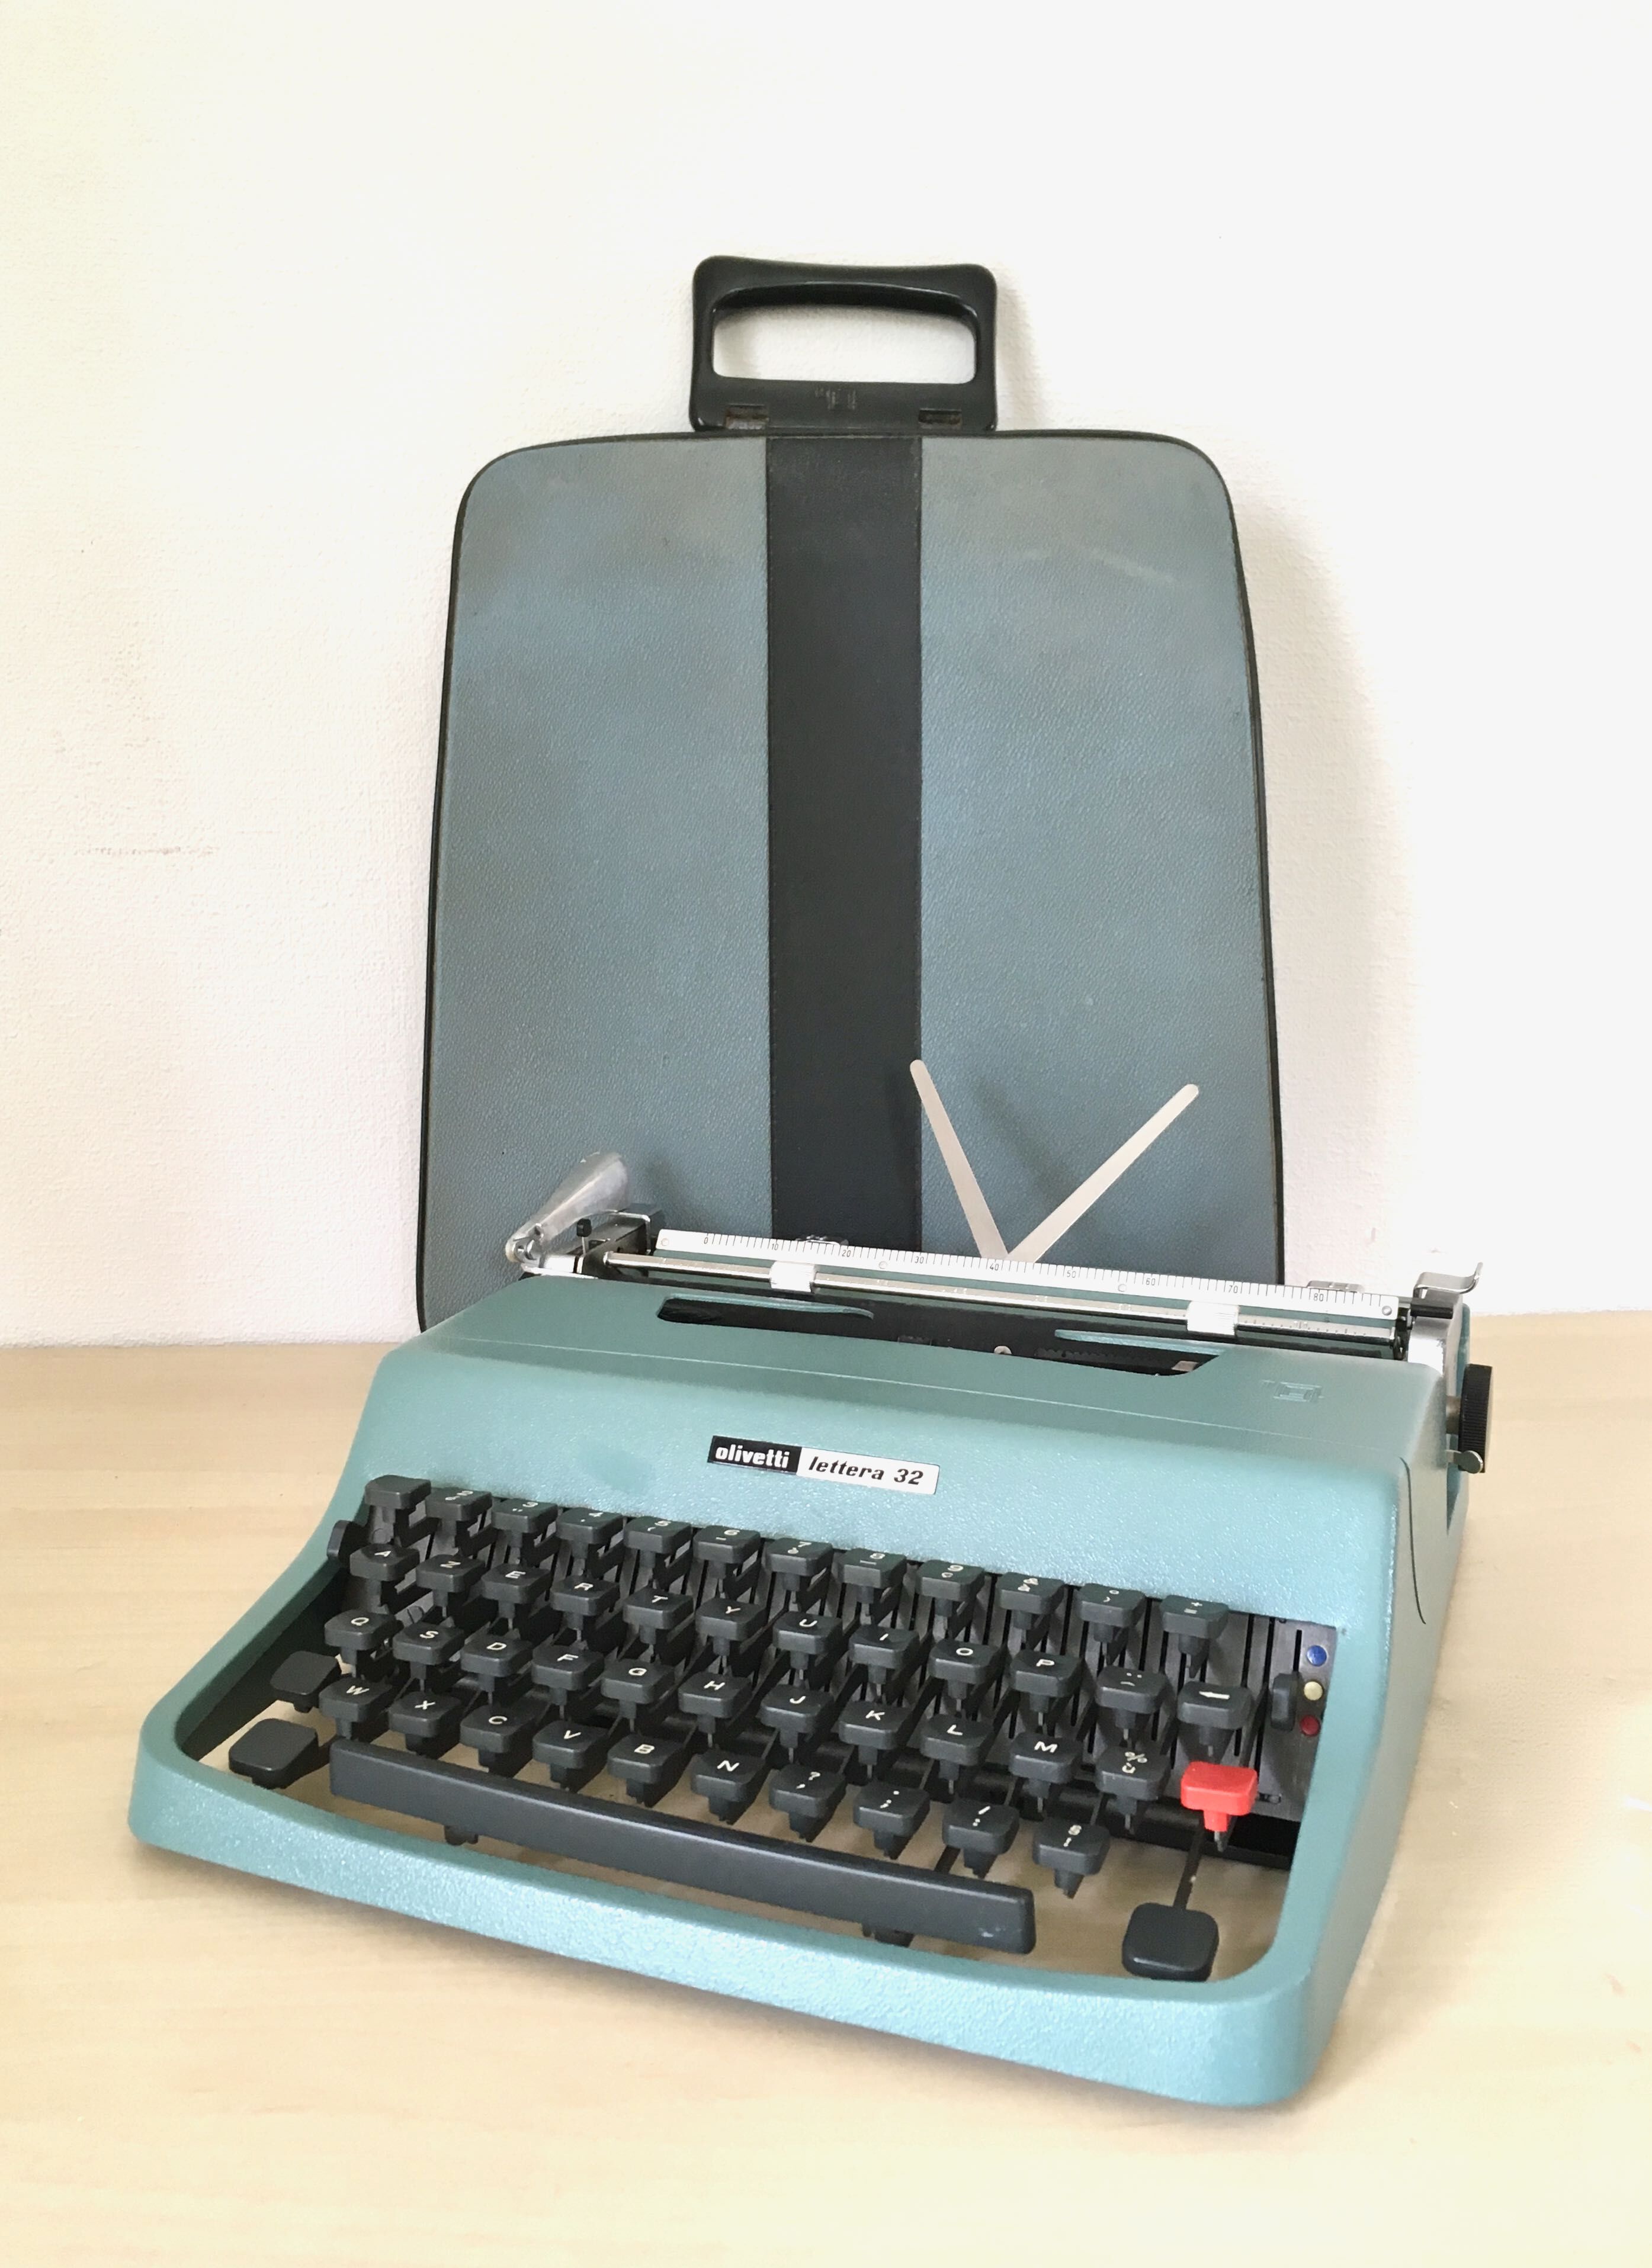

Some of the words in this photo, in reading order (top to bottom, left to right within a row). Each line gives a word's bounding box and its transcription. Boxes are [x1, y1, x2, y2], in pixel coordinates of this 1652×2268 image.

[703, 1236, 708, 1245] 0
[771, 1243, 779, 1251] 10
[841, 1249, 851, 1258] 20
[915, 1255, 925, 1264] 30
[989, 1263, 999, 1271] 40
[1066, 1270, 1076, 1278] 50
[1145, 1277, 1156, 1286] 60
[1228, 1285, 1239, 1294] 70
[1313, 1292, 1324, 1302] 80
[715, 1444, 790, 1468] olivetti
[809, 1456, 884, 1480] lettera
[894, 1469, 923, 1485] 32
[505, 1570, 526, 1579] E
[574, 1582, 594, 1591] R
[725, 1606, 741, 1614] Y
[799, 1618, 818, 1627] U
[955, 1647, 974, 1656] O
[1036, 1659, 1055, 1667] P
[346, 1685, 370, 1695] W
[415, 1700, 435, 1710] X
[488, 1716, 508, 1725] C
[563, 1730, 581, 1739] V
[634, 1744, 655, 1754] B
[717, 1760, 740, 1772] N
[351, 1617, 369, 1626] Q
[419, 1630, 439, 1639] S
[486, 1642, 507, 1650] D
[557, 1653, 579, 1662] F
[628, 1668, 647, 1676] G
[704, 1681, 726, 1691] H
[789, 1695, 806, 1704] J
[865, 1710, 885, 1721] K
[947, 1724, 963, 1736] L
[1034, 1741, 1058, 1753] M
